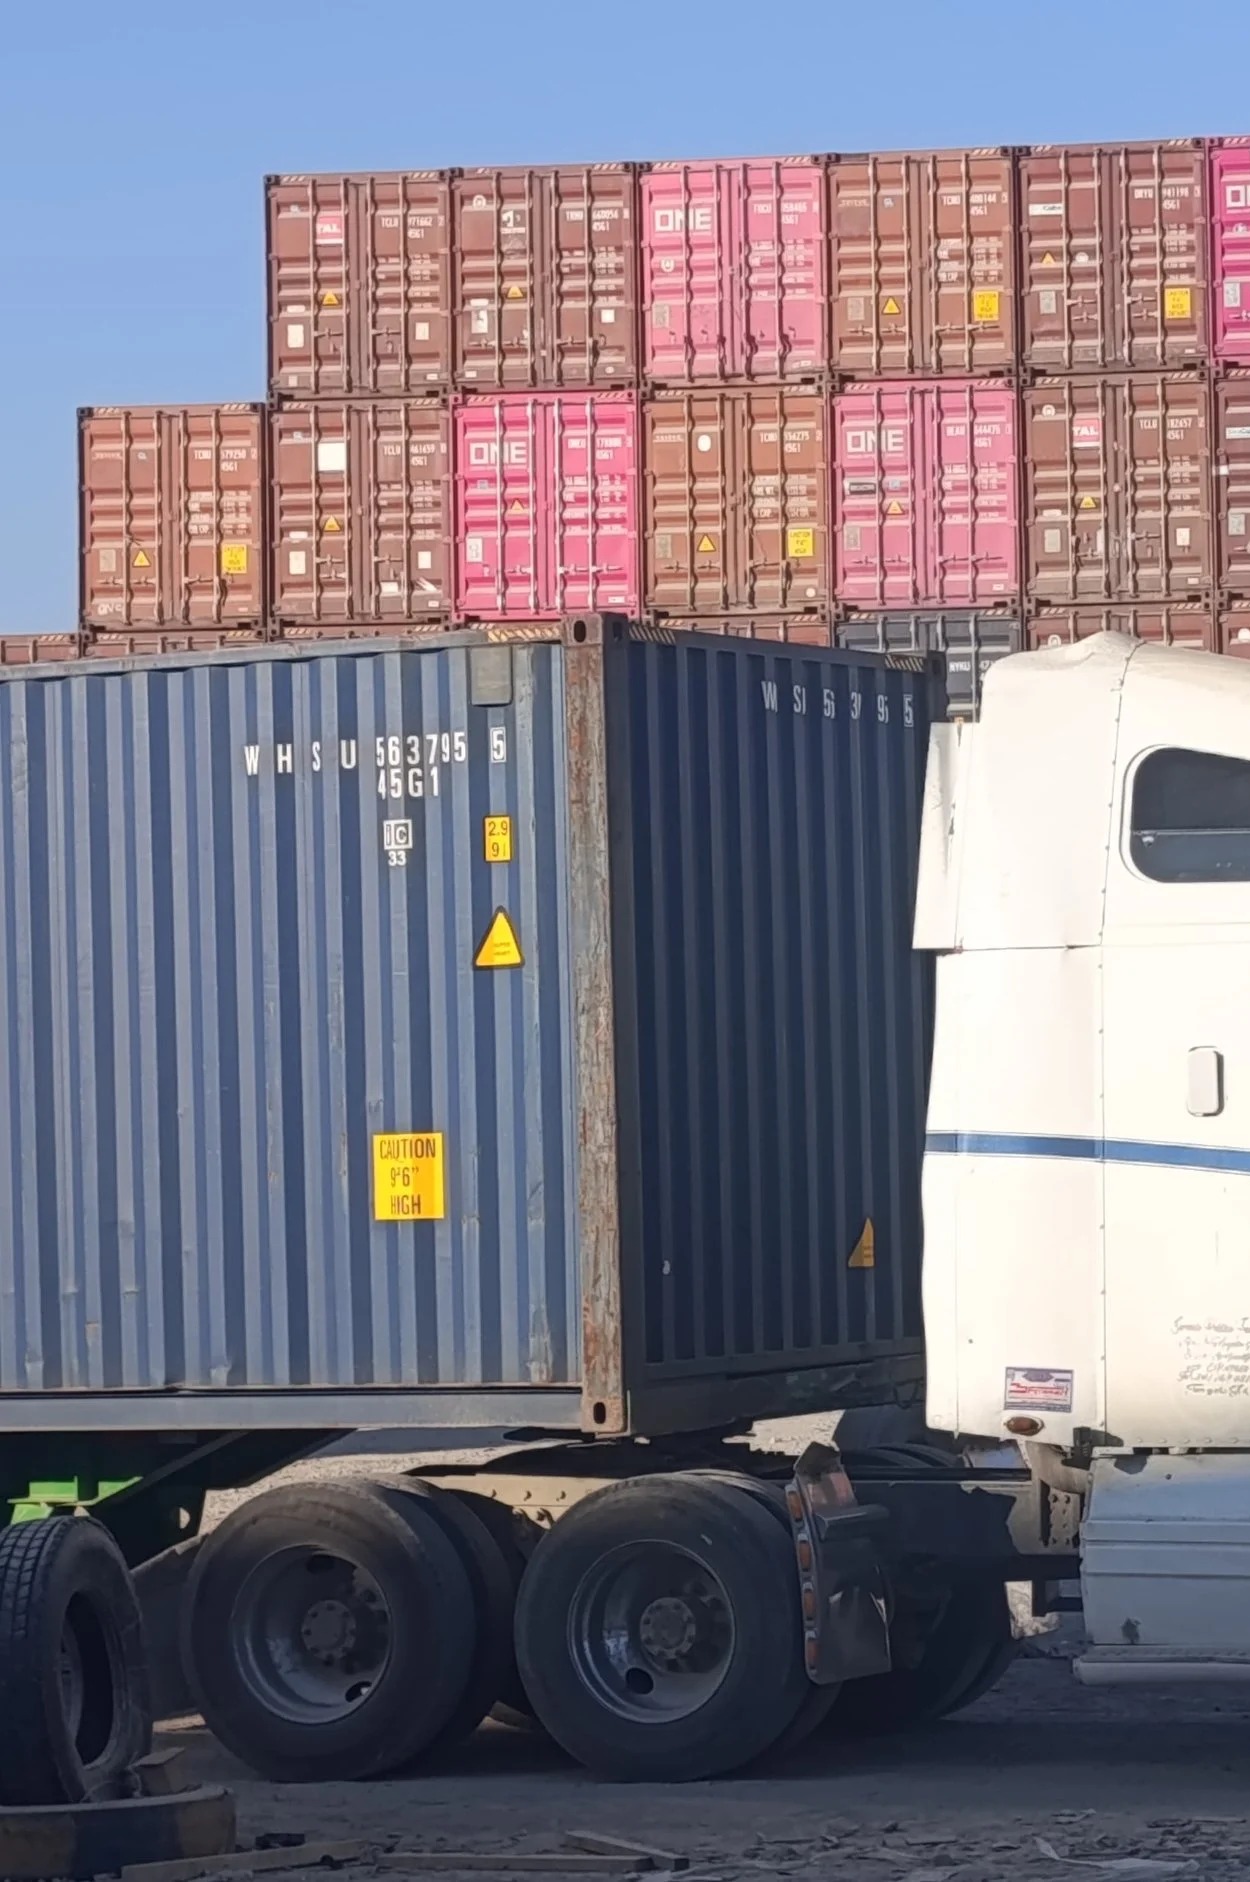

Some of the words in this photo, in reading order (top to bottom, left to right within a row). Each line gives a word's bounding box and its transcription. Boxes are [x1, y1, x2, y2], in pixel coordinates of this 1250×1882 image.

[655, 209, 711, 231] ONE
[847, 429, 904, 452] ONE
[1073, 426, 1098, 434] TAL
[470, 442, 527, 464] ONE
[377, 732, 466, 769] 563795
[492, 729, 506, 762] 5
[378, 766, 440, 798] 45G1
[489, 820, 508, 836] 2.9
[389, 850, 406, 866] 33
[380, 1138, 436, 1160] CAUTION
[390, 1194, 422, 1215] HIGH
